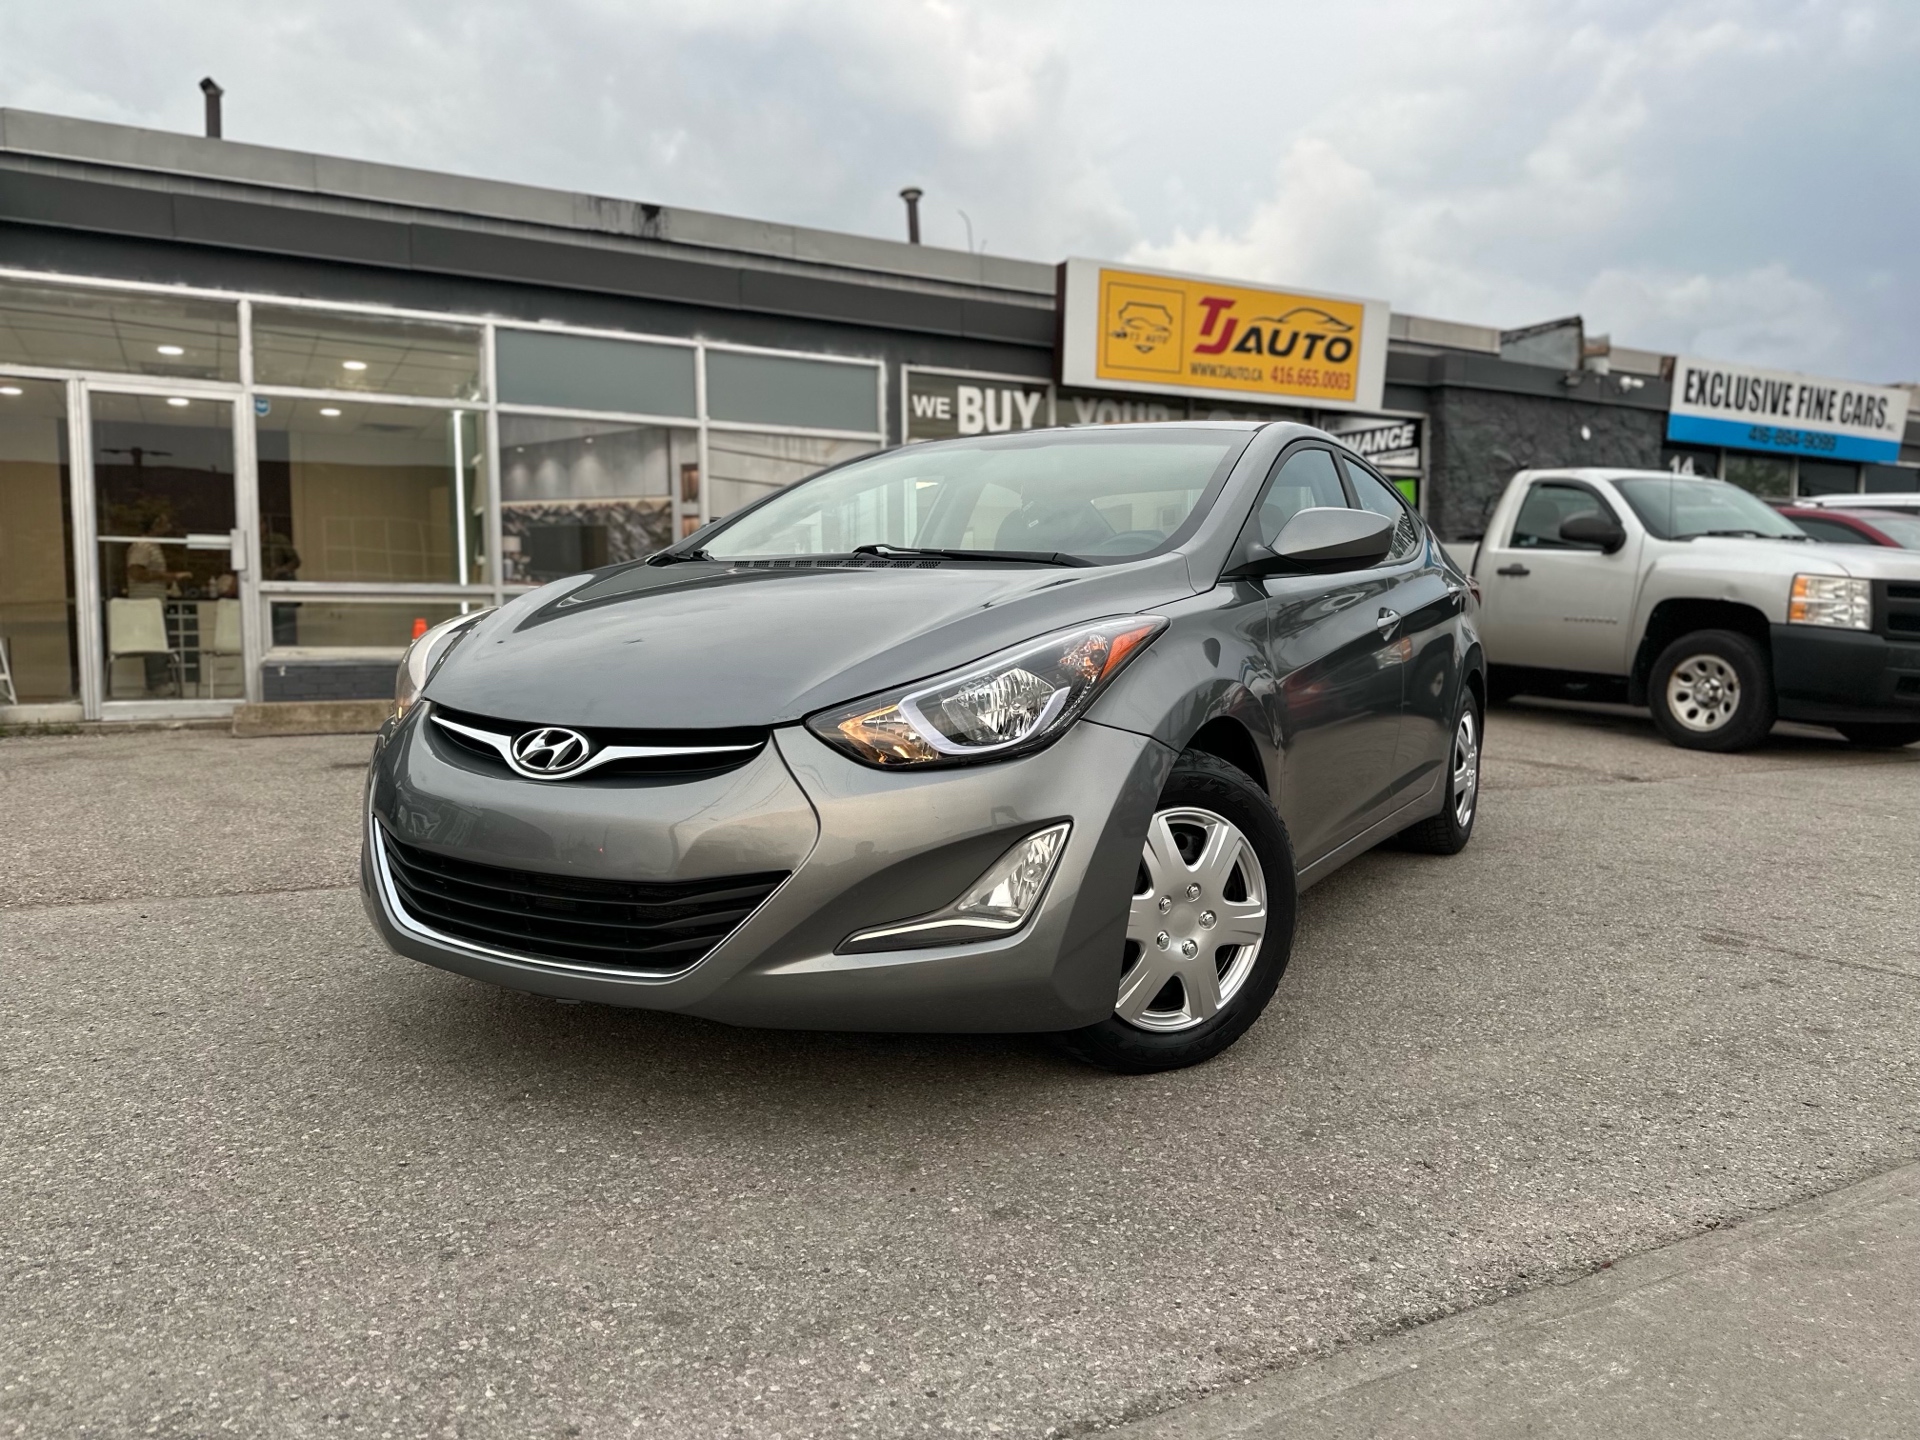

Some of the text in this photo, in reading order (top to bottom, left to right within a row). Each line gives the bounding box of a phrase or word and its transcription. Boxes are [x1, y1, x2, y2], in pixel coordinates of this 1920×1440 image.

[1233, 327, 1353, 363] AUTO
[1271, 365, 1351, 390] 416.665.0003
[912, 394, 950, 419] WE
[957, 385, 1042, 434] BUY
[1684, 368, 1889, 430] EXCLUSIVE FINE CARS
[1669, 455, 1695, 474] 14
